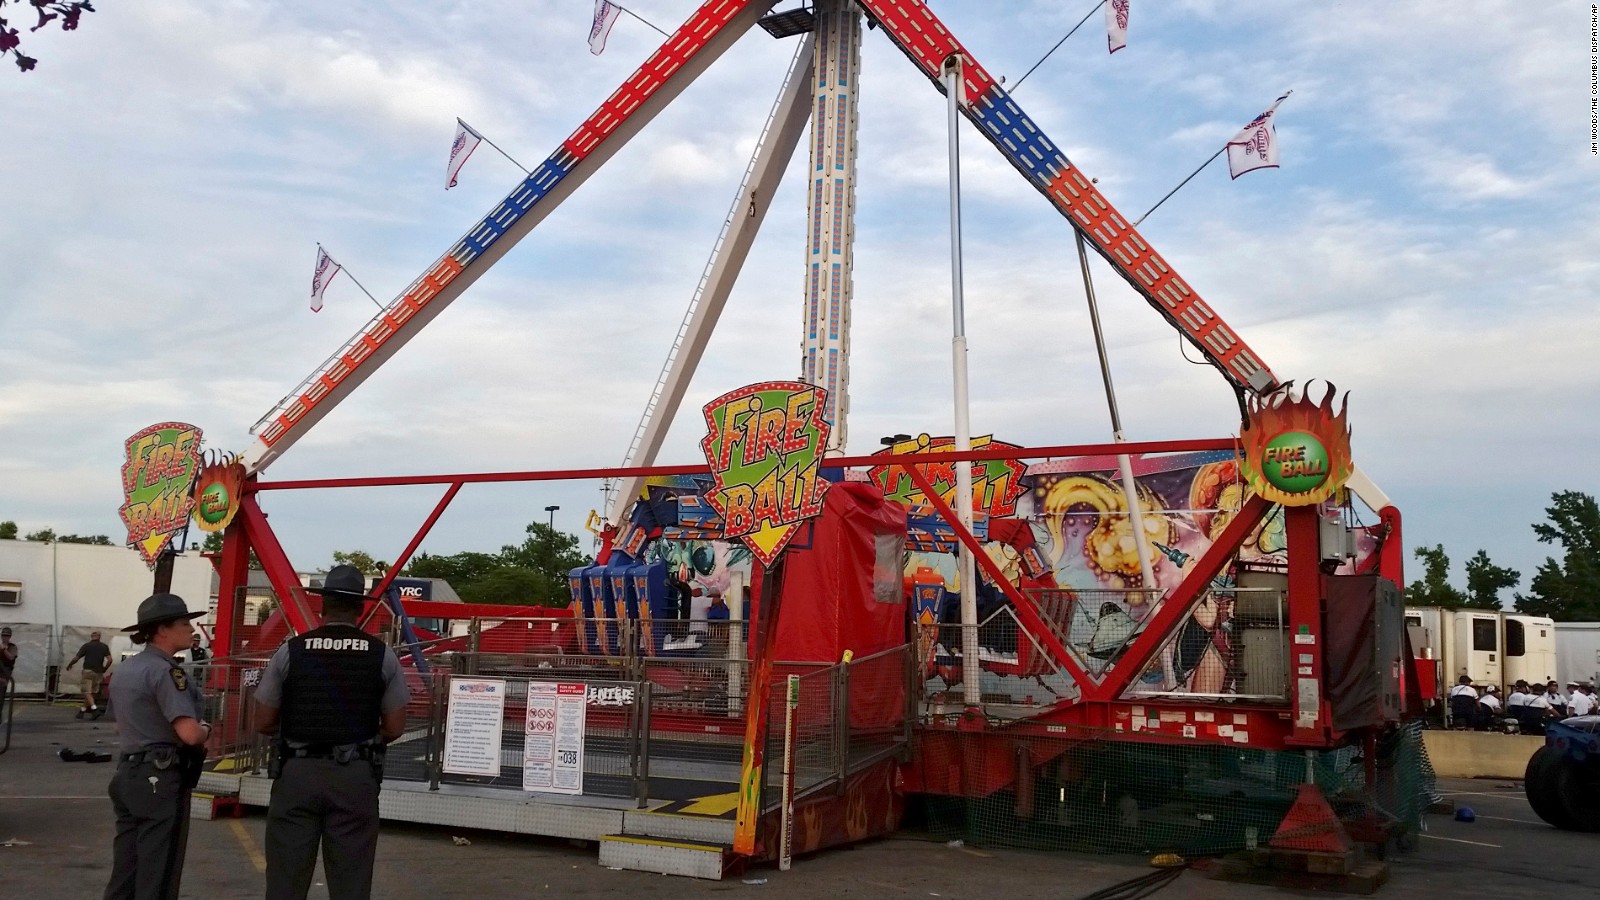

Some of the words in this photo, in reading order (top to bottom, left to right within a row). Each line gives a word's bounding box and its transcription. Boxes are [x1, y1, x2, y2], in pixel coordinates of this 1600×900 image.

[1264, 445, 1306, 464] FIRE
[1281, 459, 1325, 478] BALL
[201, 492, 220, 504] FIRE
[720, 457, 824, 540] BALL
[904, 471, 1017, 518] LL
[126, 482, 190, 545] BALL
[207, 502, 226, 515] BALL
[399, 586, 423, 597] YRC
[304, 637, 369, 651] TROOPER
[588, 687, 634, 701] ENTER
[563, 752, 577, 765] 038
